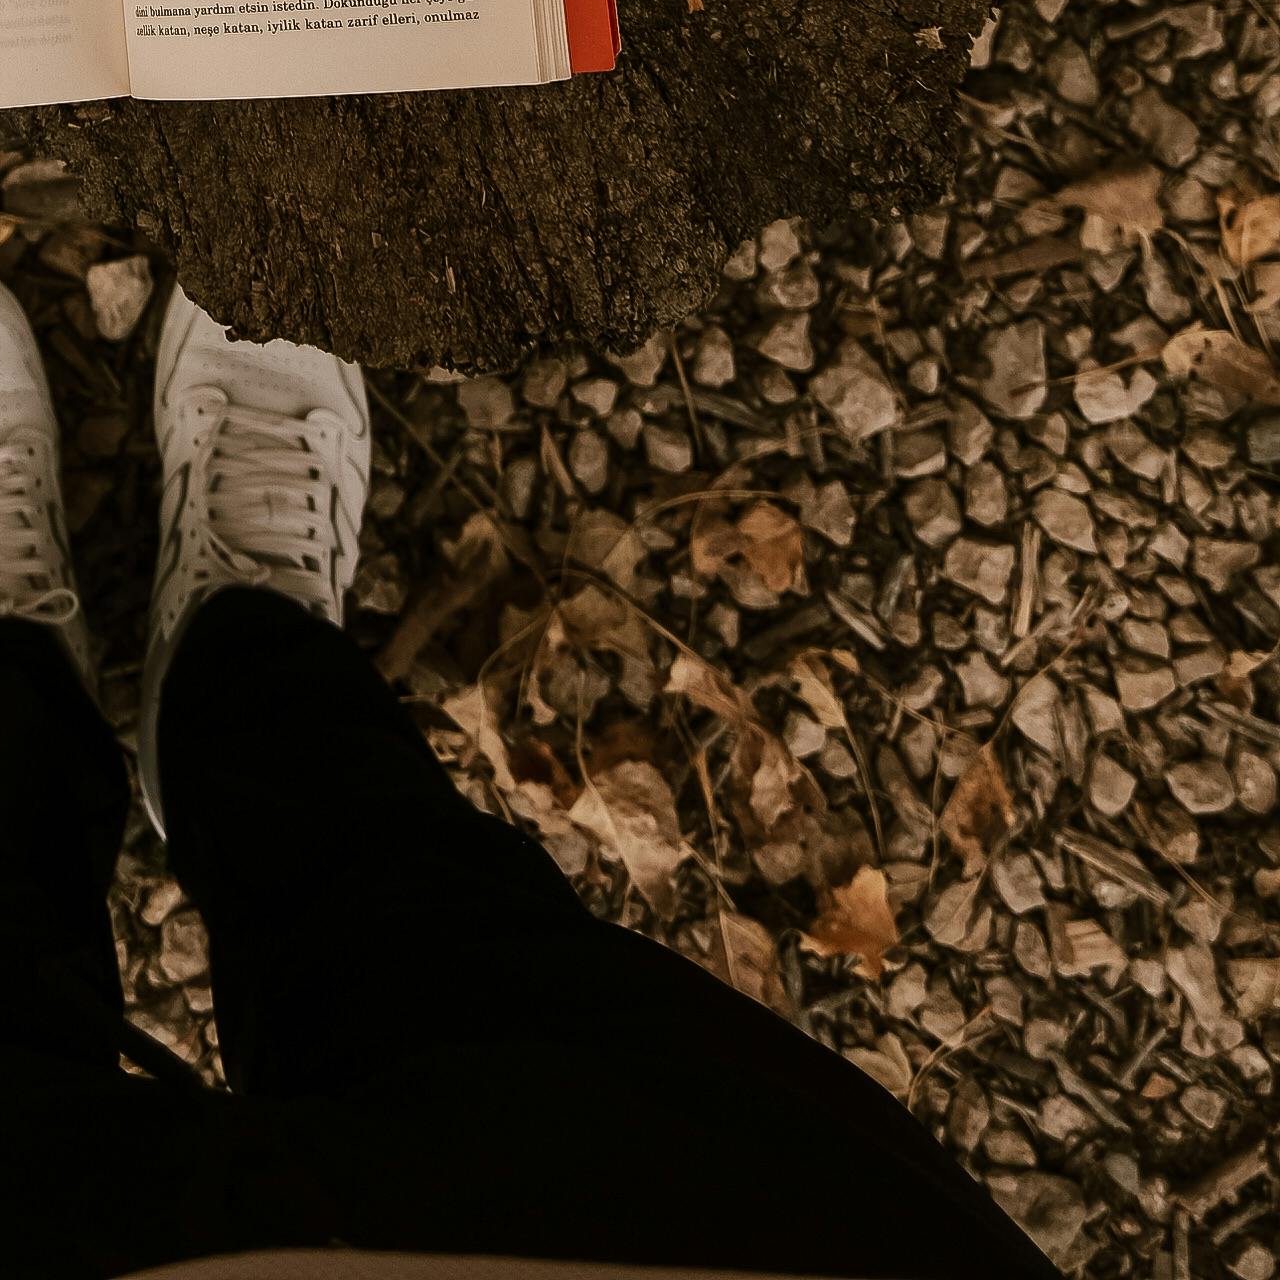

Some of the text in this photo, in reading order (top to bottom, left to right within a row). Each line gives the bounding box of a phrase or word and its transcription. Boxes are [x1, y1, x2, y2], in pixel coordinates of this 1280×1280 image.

[158, 24, 190, 38] katan,
[193, 25, 220, 38] neşe
[223, 22, 263, 34] katan,
[267, 18, 301, 35] iyilik
[304, 18, 343, 30] katan
[347, 14, 379, 28] zarif
[382, 12, 420, 26] elleri,
[424, 9, 480, 23] onulmaz
